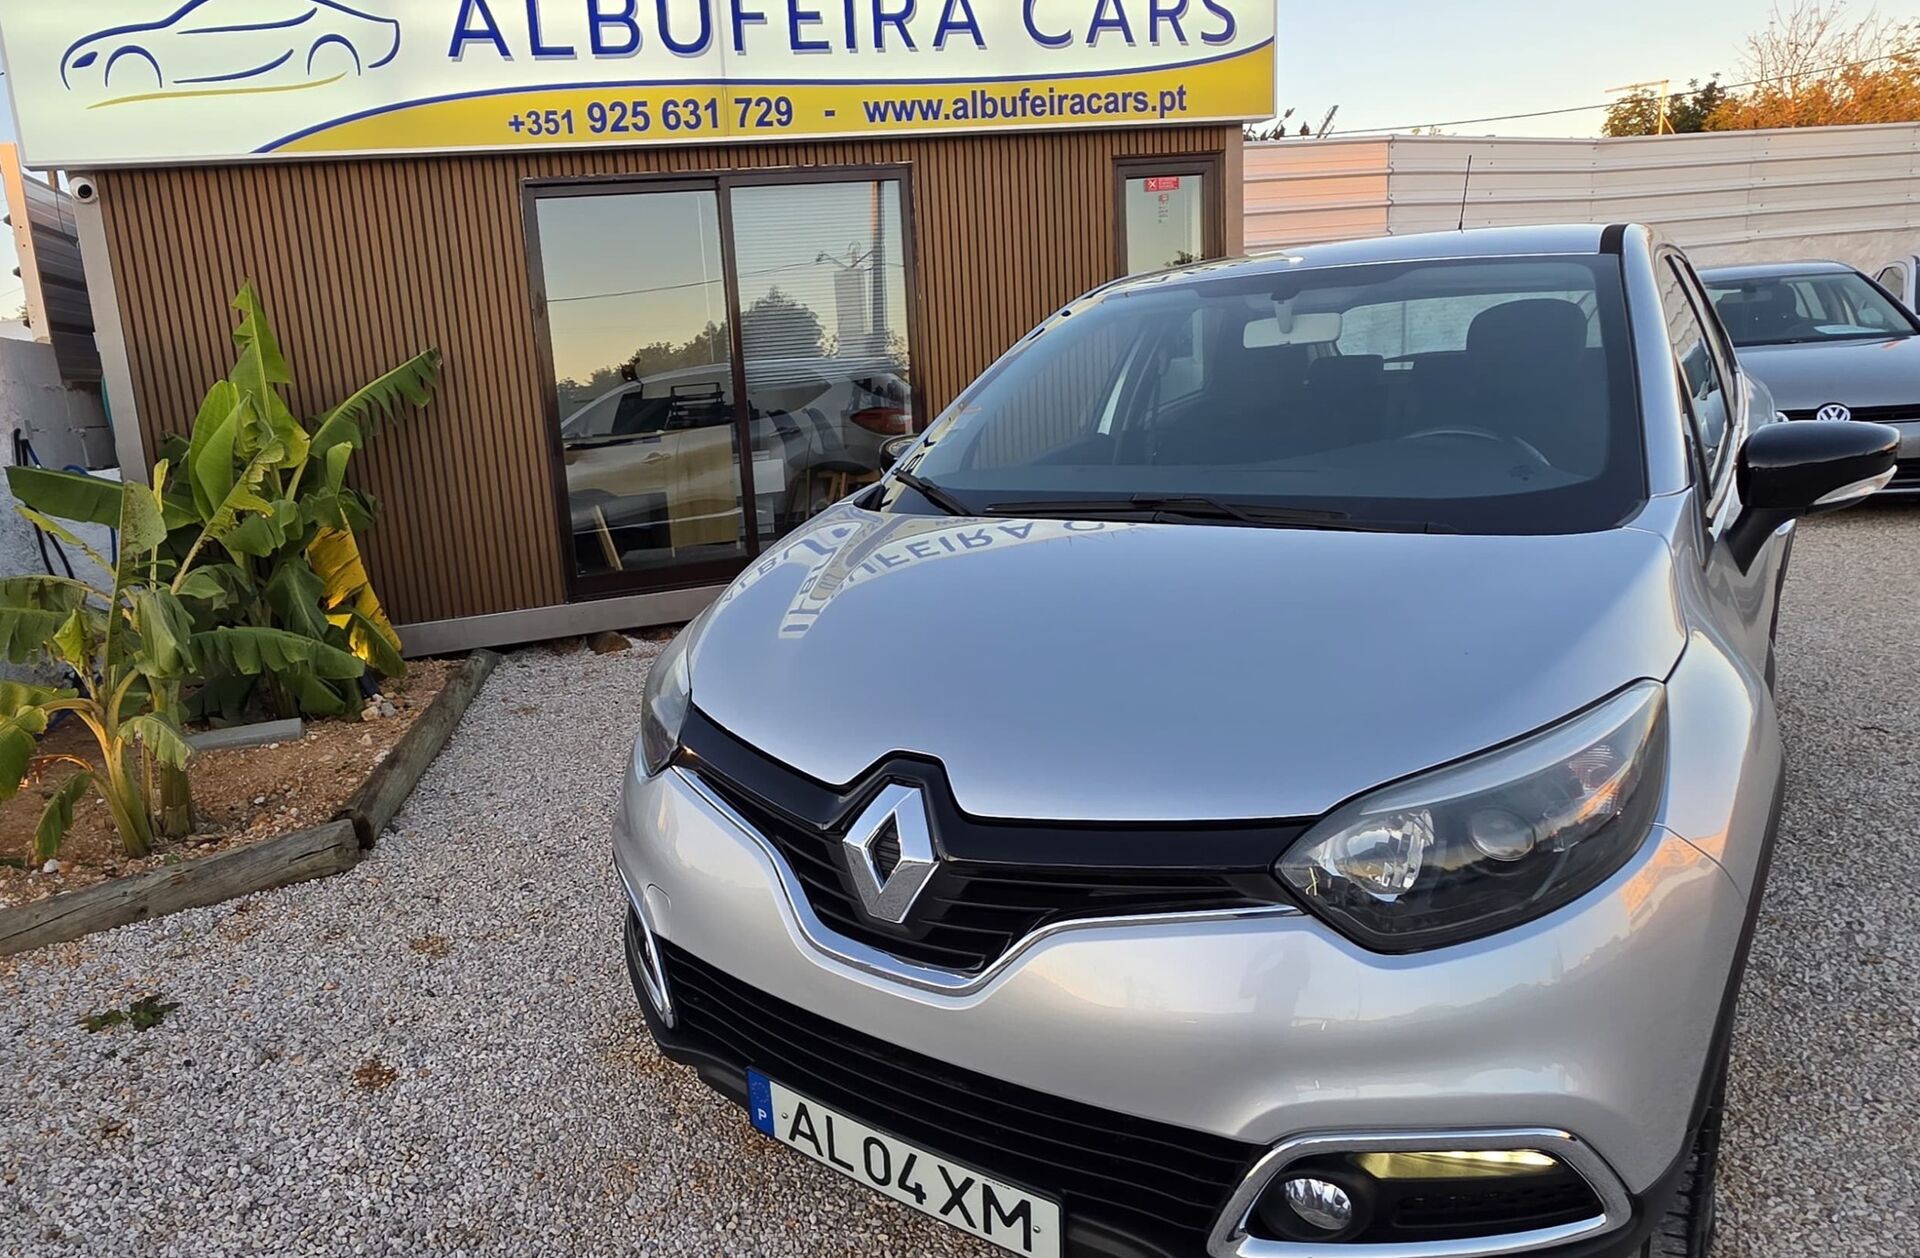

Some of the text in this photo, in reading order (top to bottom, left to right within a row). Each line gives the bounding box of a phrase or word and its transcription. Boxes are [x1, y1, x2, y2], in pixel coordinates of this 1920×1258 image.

[448, 0, 1238, 61] ALBUFEIRA CARS
[508, 109, 574, 136] +351
[587, 101, 650, 133] 925
[661, 98, 719, 130] 631
[734, 96, 792, 128] 729
[863, 84, 1187, 122] www.albufeiracars.pt
[758, 1107, 768, 1122] P
